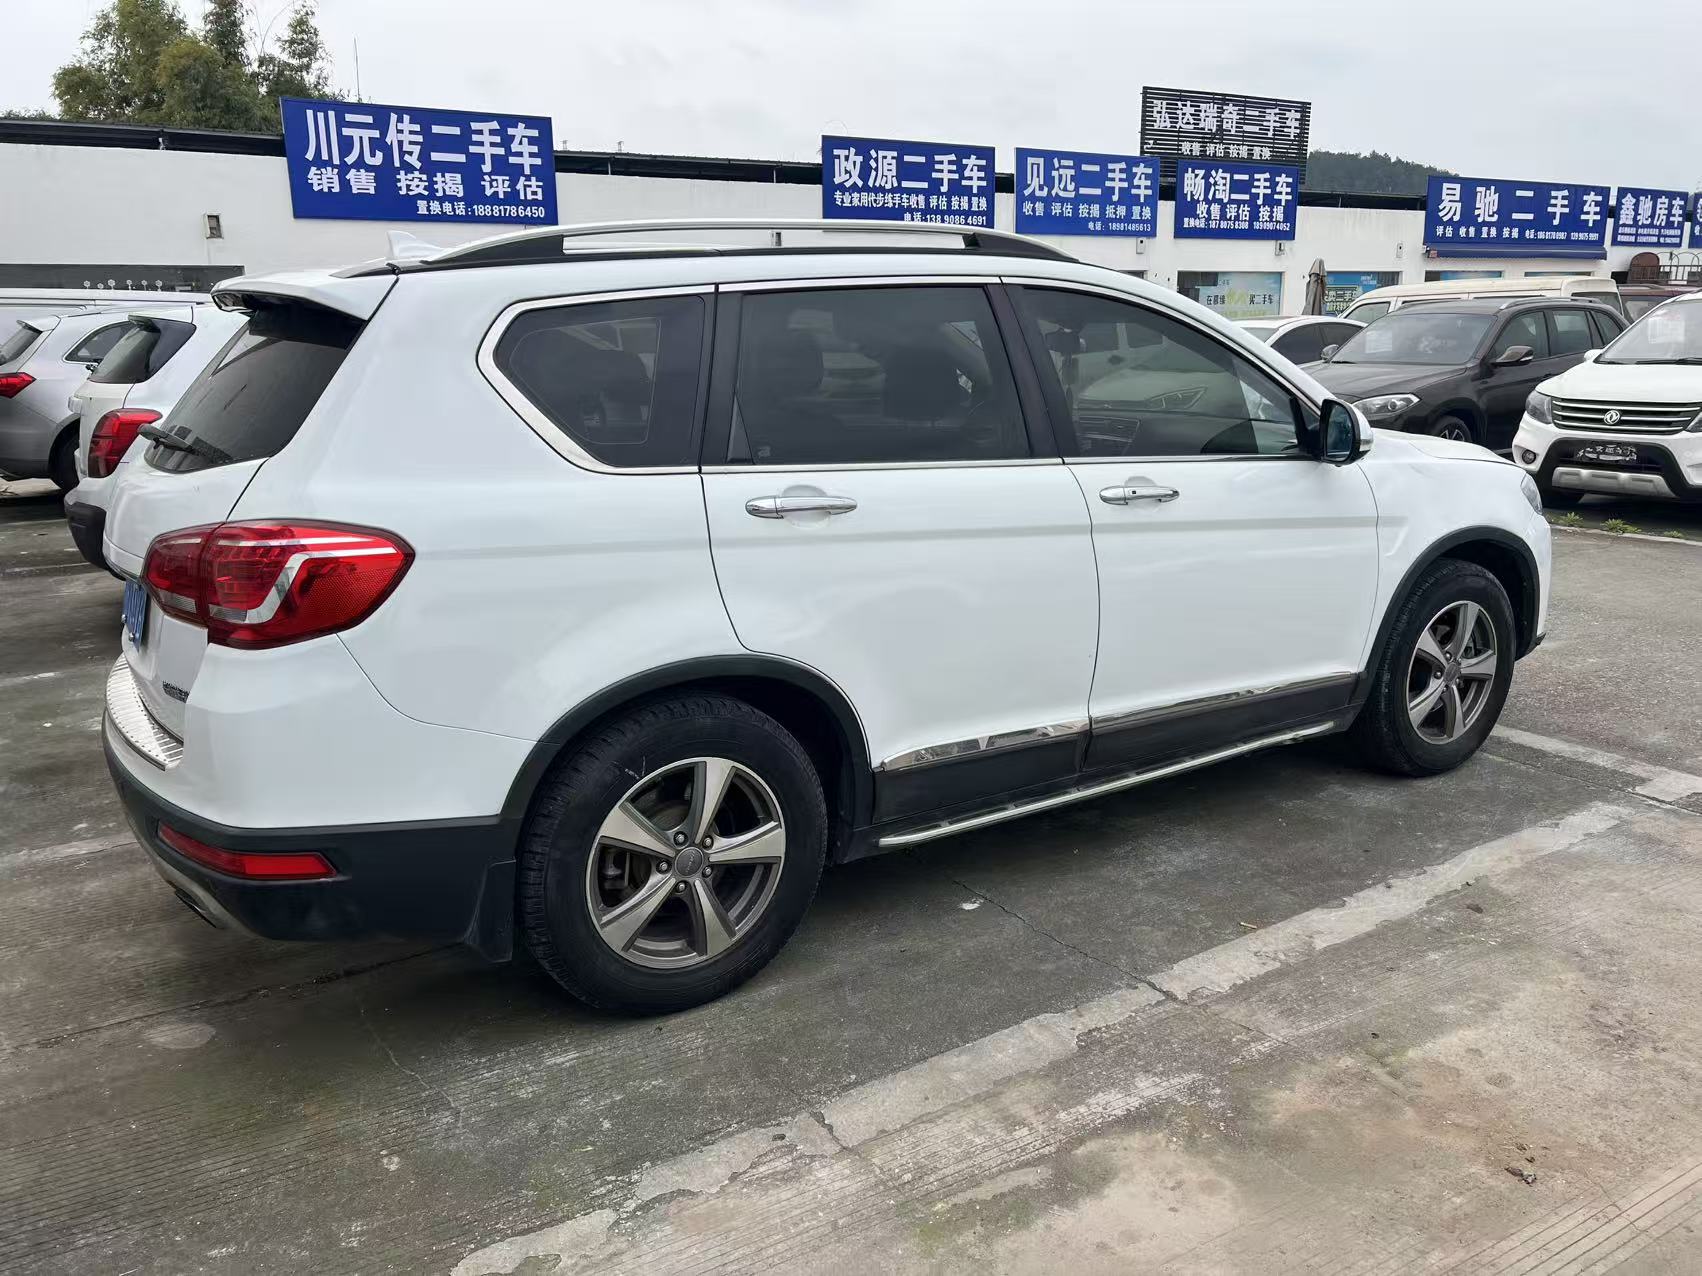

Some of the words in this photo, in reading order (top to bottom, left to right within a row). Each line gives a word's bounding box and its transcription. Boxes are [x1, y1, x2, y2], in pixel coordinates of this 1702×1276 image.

[304, 109, 543, 175] 川元传二手车
[1181, 141, 1201, 156] 收售
[1206, 143, 1224, 157] 评估
[307, 166, 377, 194] 销售
[395, 170, 465, 198] 按揭
[480, 174, 544, 201] 评估
[833, 146, 988, 193] 政源二手车
[1023, 156, 1153, 203] 见远二手车
[1183, 167, 1293, 206] 畅淘二手车
[416, 200, 545, 218] 置换电话:18881786450
[834, 190, 926, 208] 专业家用代步练手车收售
[929, 195, 947, 210] 评估
[951, 196, 969, 211] 按揭
[971, 196, 987, 211] 置换
[1022, 201, 1045, 216] 收售
[1051, 202, 1073, 217] 评估
[1079, 203, 1100, 218] 按揭
[1106, 204, 1126, 219] 抵押
[1131, 206, 1152, 220] 置换
[1196, 202, 1221, 220] 收售
[1225, 204, 1251, 221] 评估
[1258, 205, 1284, 222] 按揭
[1437, 182, 1604, 227] 易驰二手车
[1619, 193, 1685, 227] 鑫驰房车
[1436, 225, 1453, 237] 评估
[1459, 226, 1476, 238] 收售
